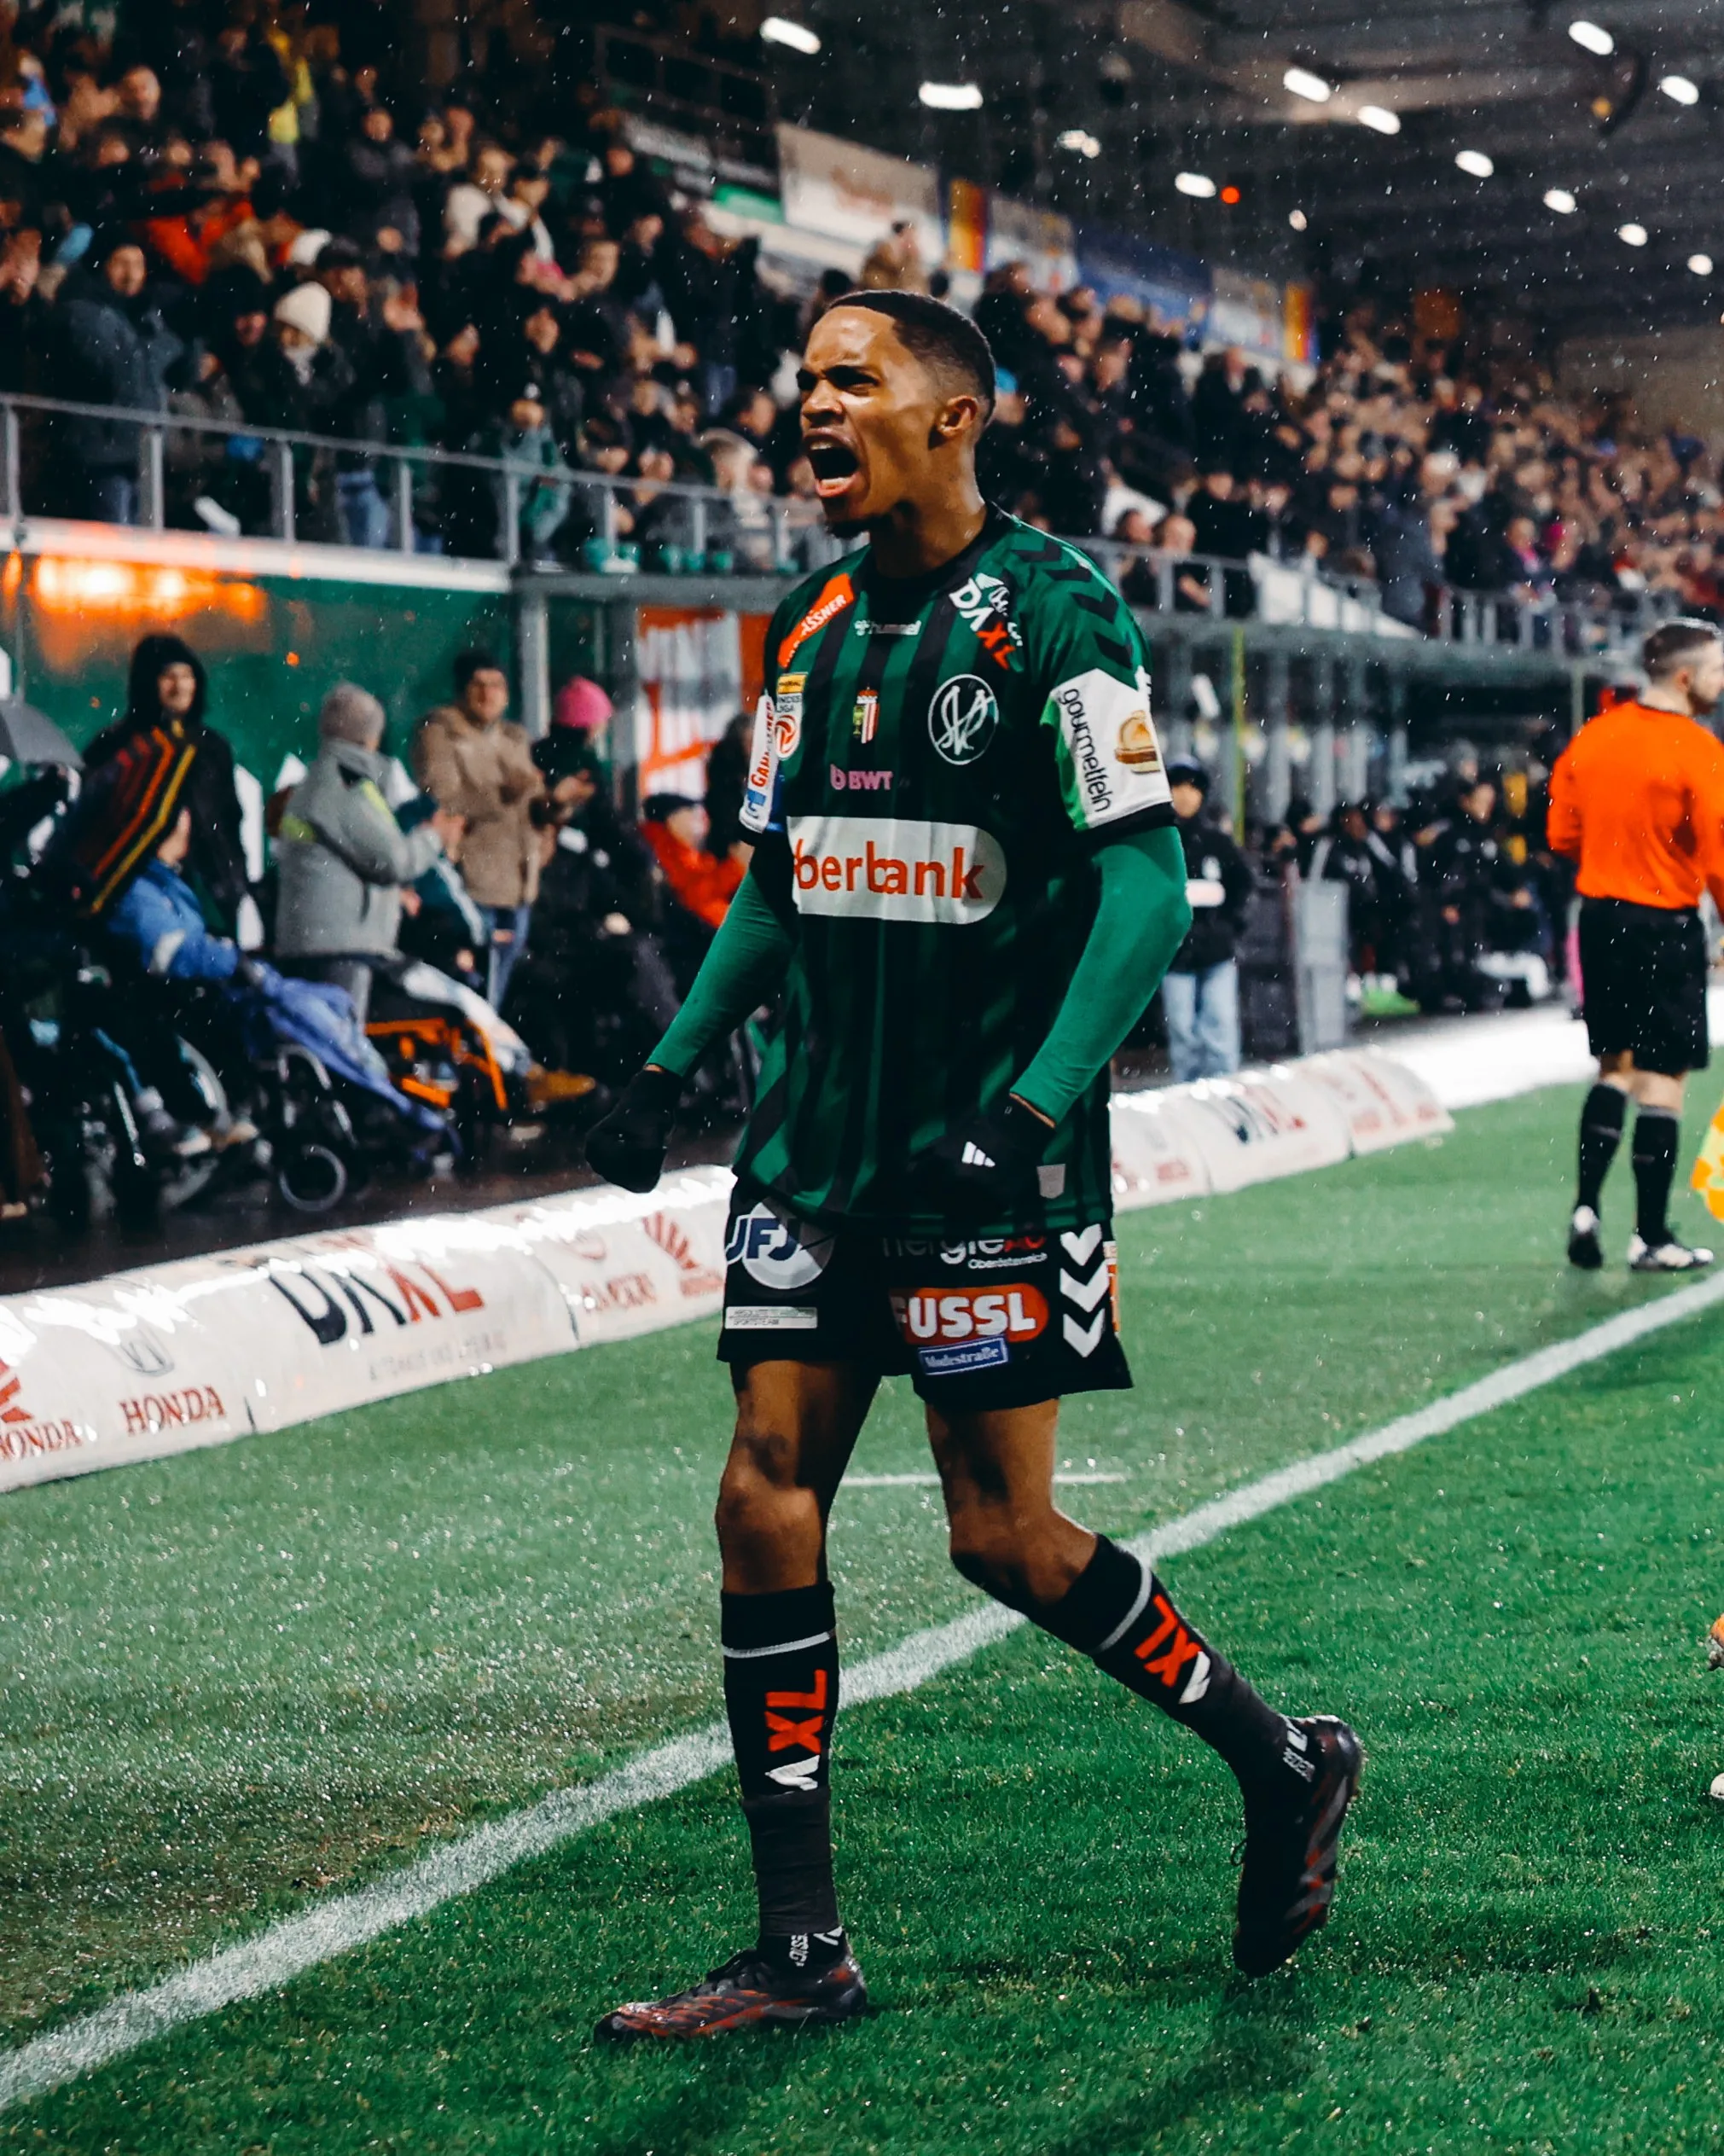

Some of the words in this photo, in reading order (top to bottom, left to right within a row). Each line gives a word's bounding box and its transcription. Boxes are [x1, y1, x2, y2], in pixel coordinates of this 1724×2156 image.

[1058, 688, 1113, 813] gourmetfein
[793, 838, 985, 899] berbank
[119, 1383, 227, 1436] HONDA
